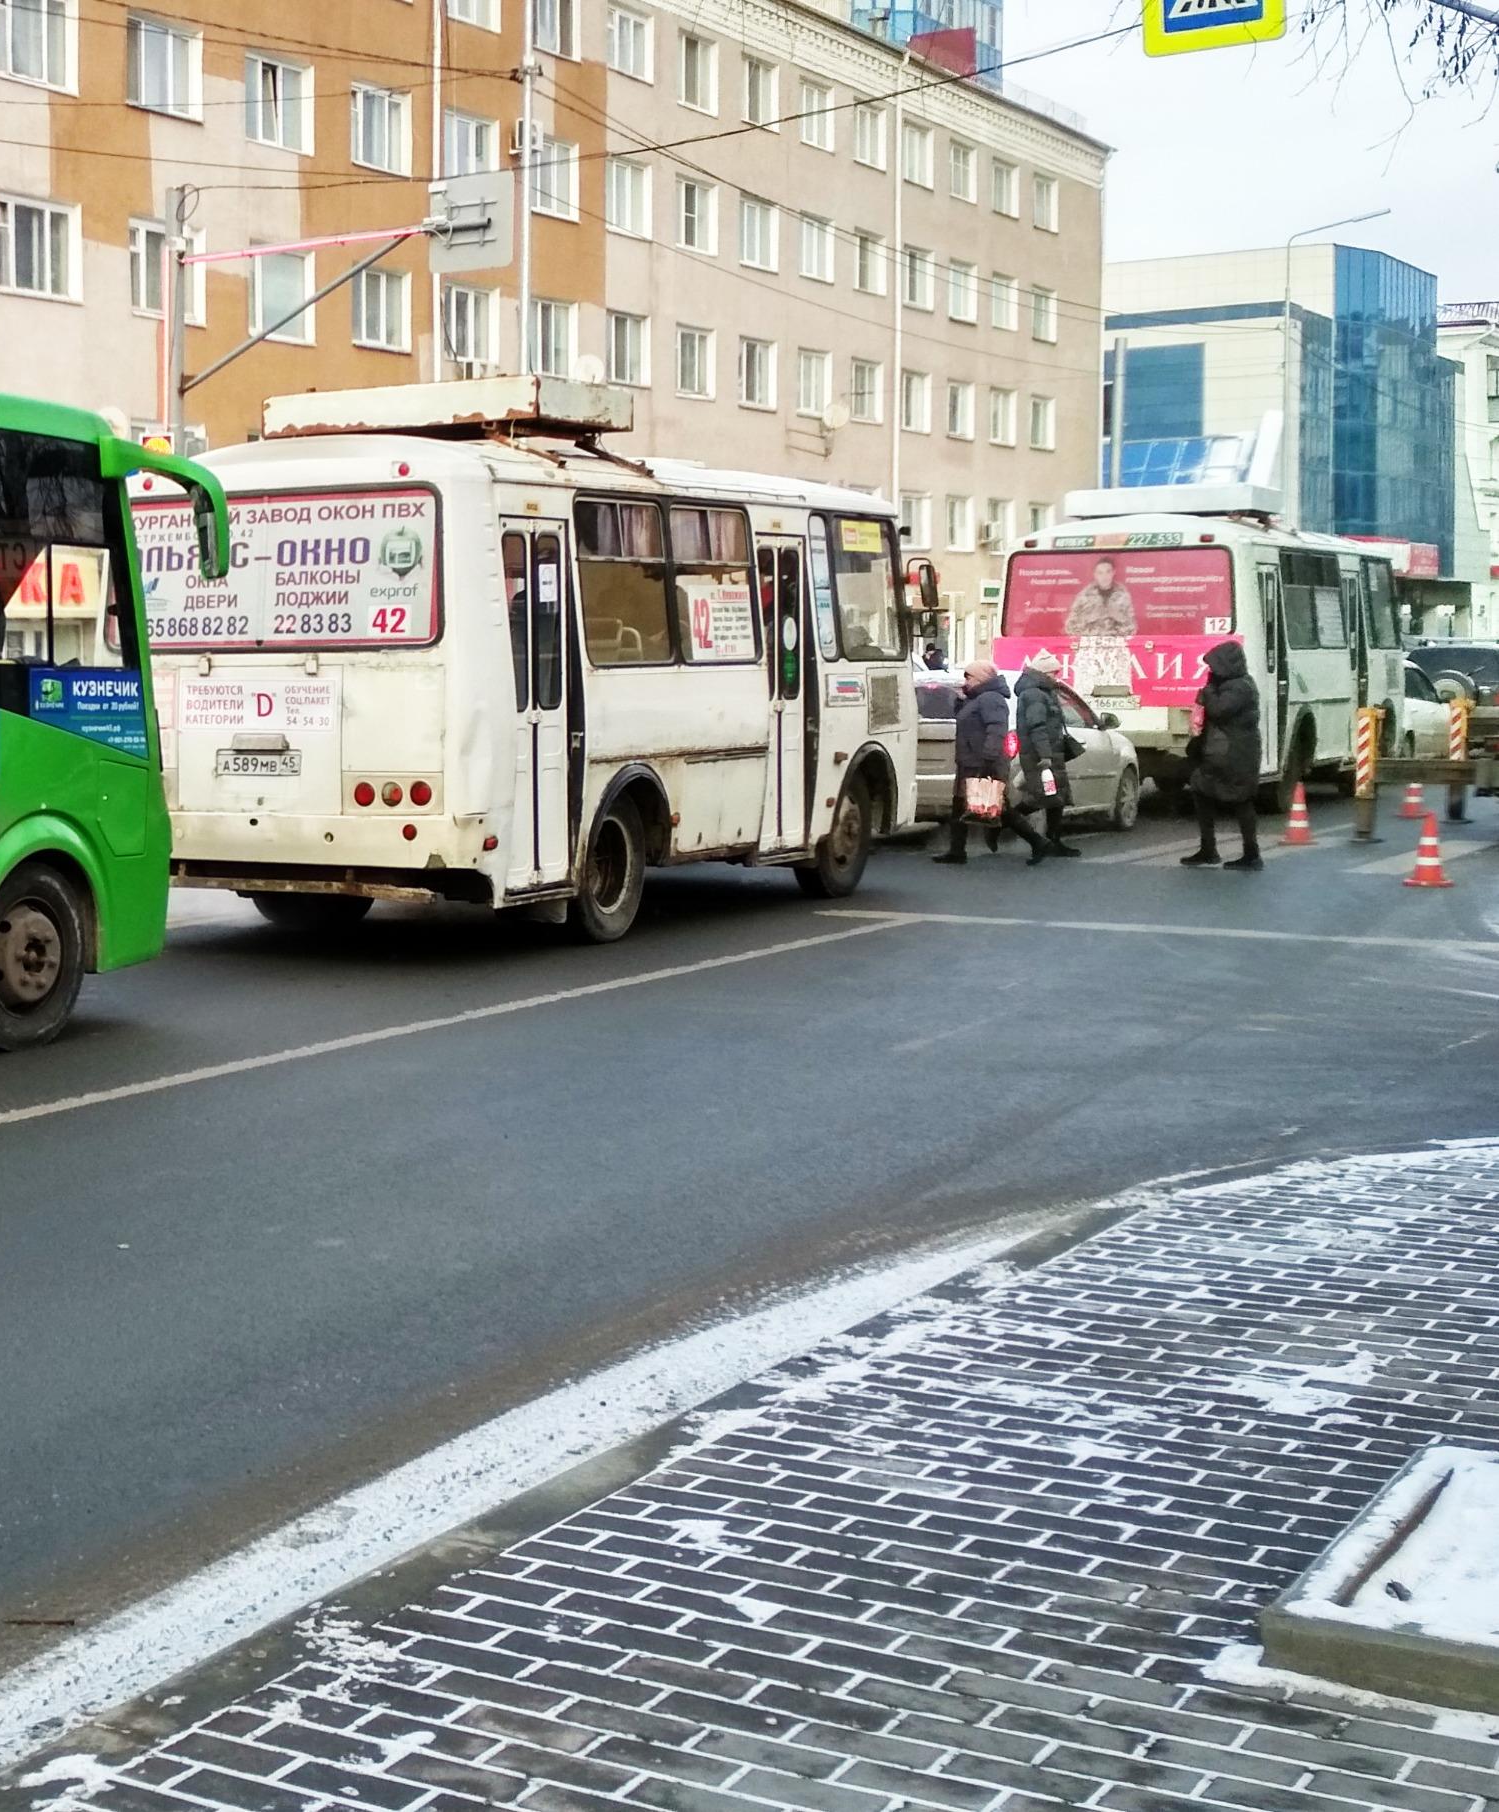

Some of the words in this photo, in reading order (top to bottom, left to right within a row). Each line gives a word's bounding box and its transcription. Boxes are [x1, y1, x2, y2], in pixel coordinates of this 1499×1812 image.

[246, 507, 312, 524] ЗАВОД
[317, 504, 375, 521] ОКОН
[382, 502, 426, 519] ПВХ
[1129, 533, 1181, 545] 227-533
[185, 574, 229, 590] ОКНА
[275, 569, 361, 586] БАЛКОНЫ
[369, 583, 420, 600] exprof
[184, 594, 238, 612] ДВЕРИ
[274, 591, 349, 609] ЛОДЖИИ
[372, 607, 406, 634] 42
[693, 598, 713, 649] 42
[1209, 618, 1227, 632] 12
[72, 680, 139, 697] КУЗНЕЧИК
[187, 685, 244, 696] ТРЕБУЮТСЯ
[284, 685, 331, 694] ОБУЧЕНИЕ
[186, 699, 244, 711] ВОДИТЕЛИ
[185, 715, 244, 725] КАТЕГОРИИ
[282, 757, 296, 769] 45
